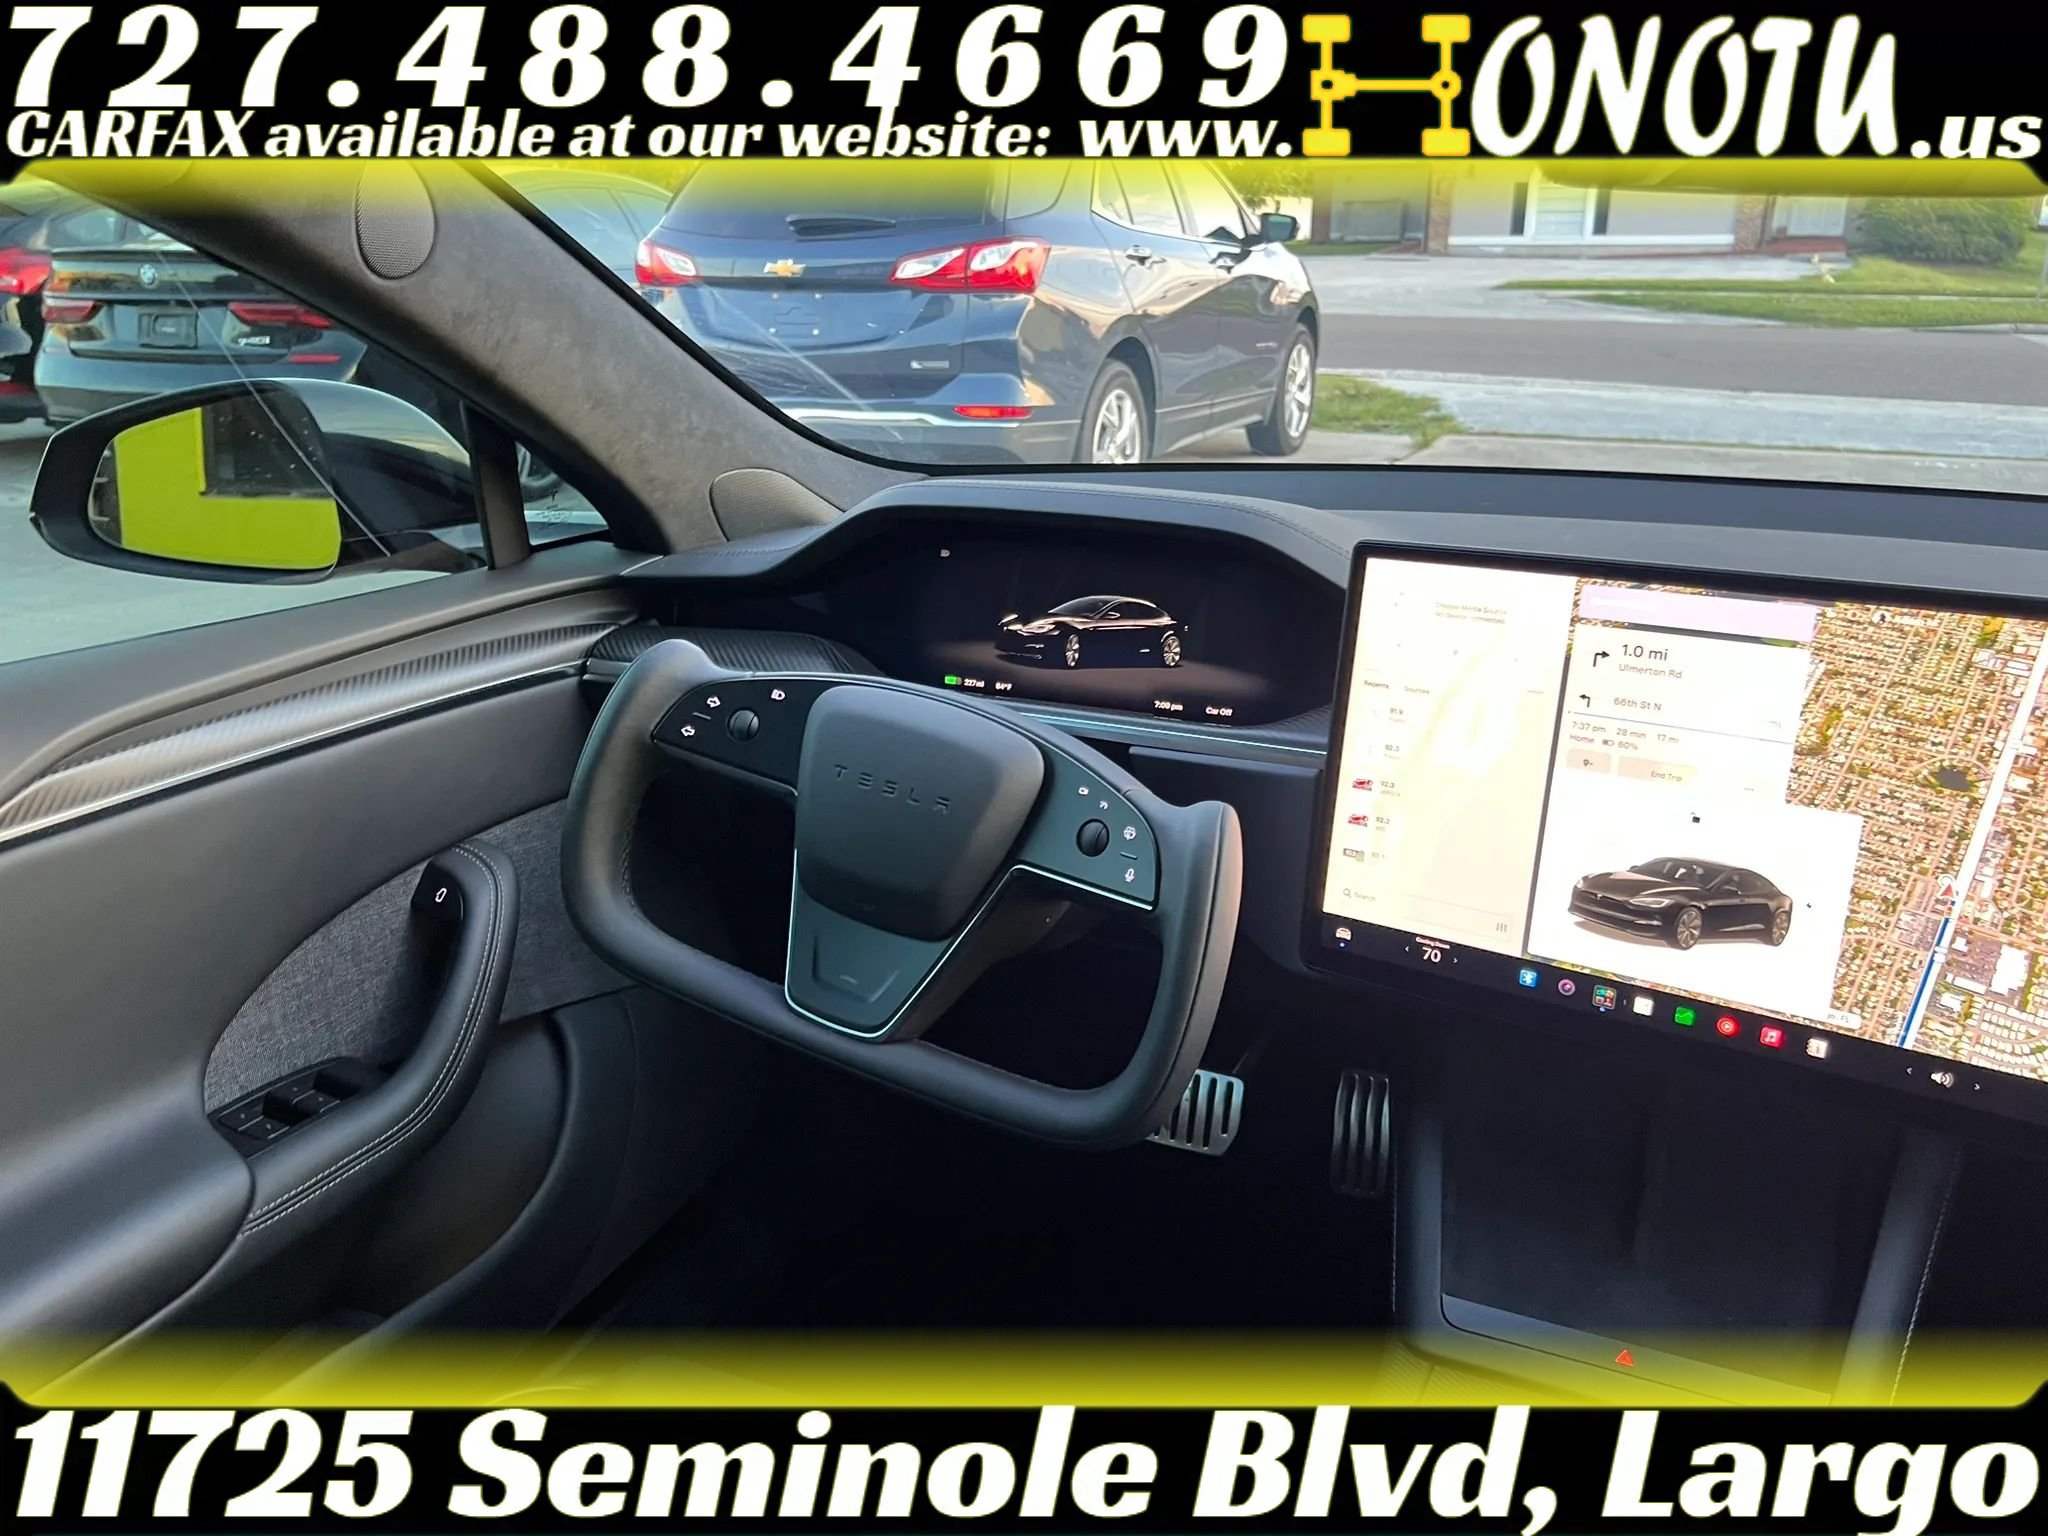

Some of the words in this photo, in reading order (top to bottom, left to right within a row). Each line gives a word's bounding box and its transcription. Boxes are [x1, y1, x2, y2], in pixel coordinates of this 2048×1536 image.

[1621, 644, 1643, 659] 1.0
[1648, 647, 1669, 662] mi
[1618, 663, 1667, 678] Ulmerton
[1668, 669, 1683, 680] Rd
[1613, 697, 1638, 709] 66th
[1640, 700, 1652, 710] St
[1653, 702, 1662, 712] N
[832, 763, 952, 816] TESLA
[1422, 946, 1442, 963] 70
